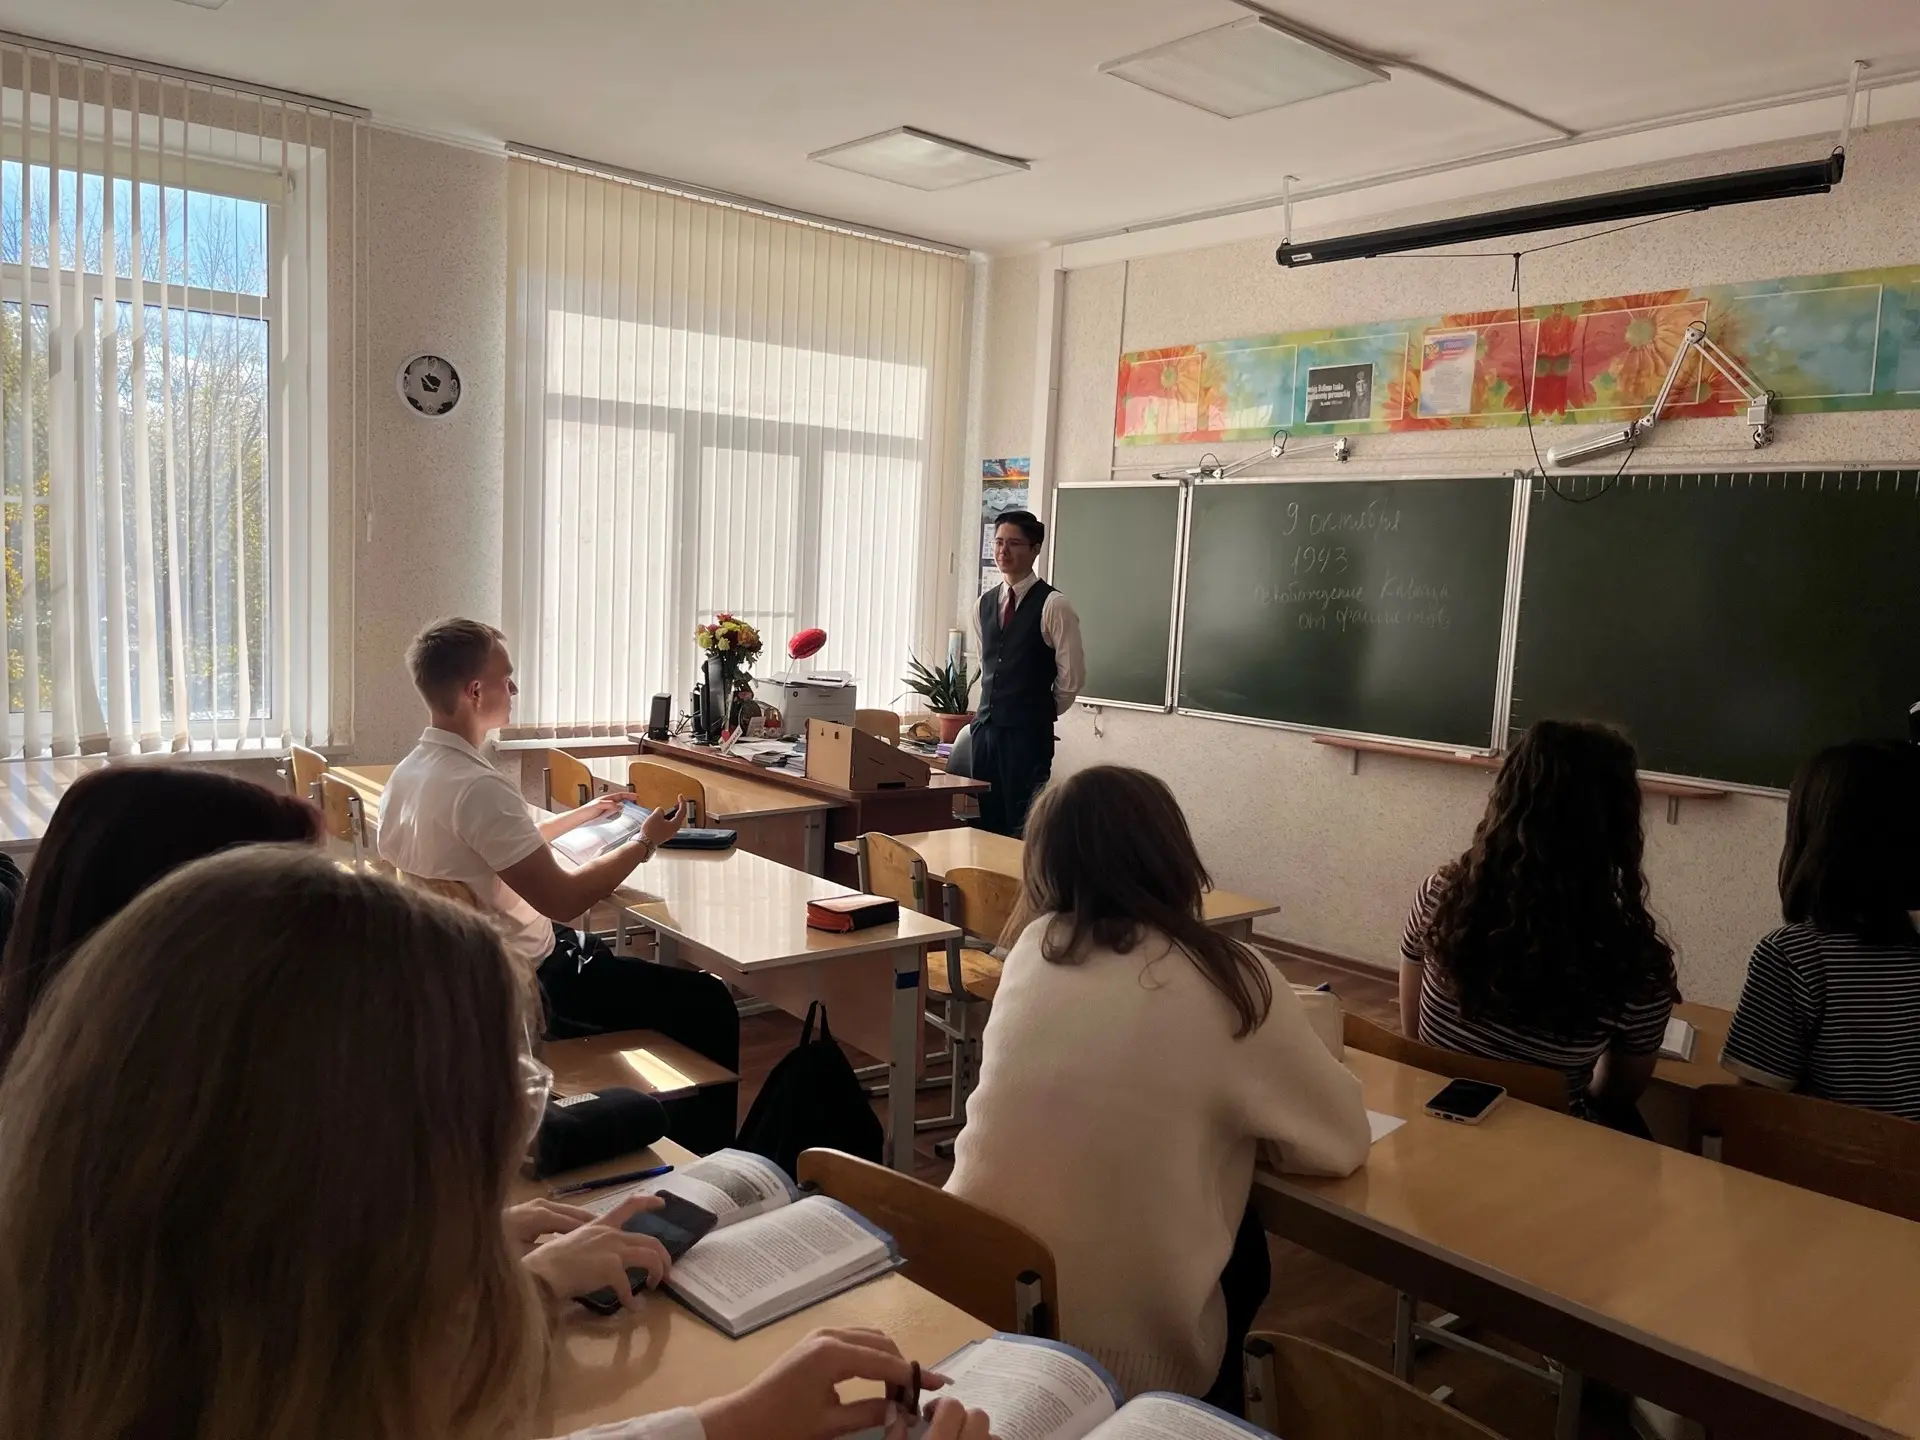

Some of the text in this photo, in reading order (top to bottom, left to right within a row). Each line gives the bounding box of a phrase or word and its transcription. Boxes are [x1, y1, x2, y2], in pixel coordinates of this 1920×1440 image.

[1282, 498, 1401, 541] 9 октября
[1290, 545, 1350, 576] 1943
[1298, 611, 1327, 632] от
